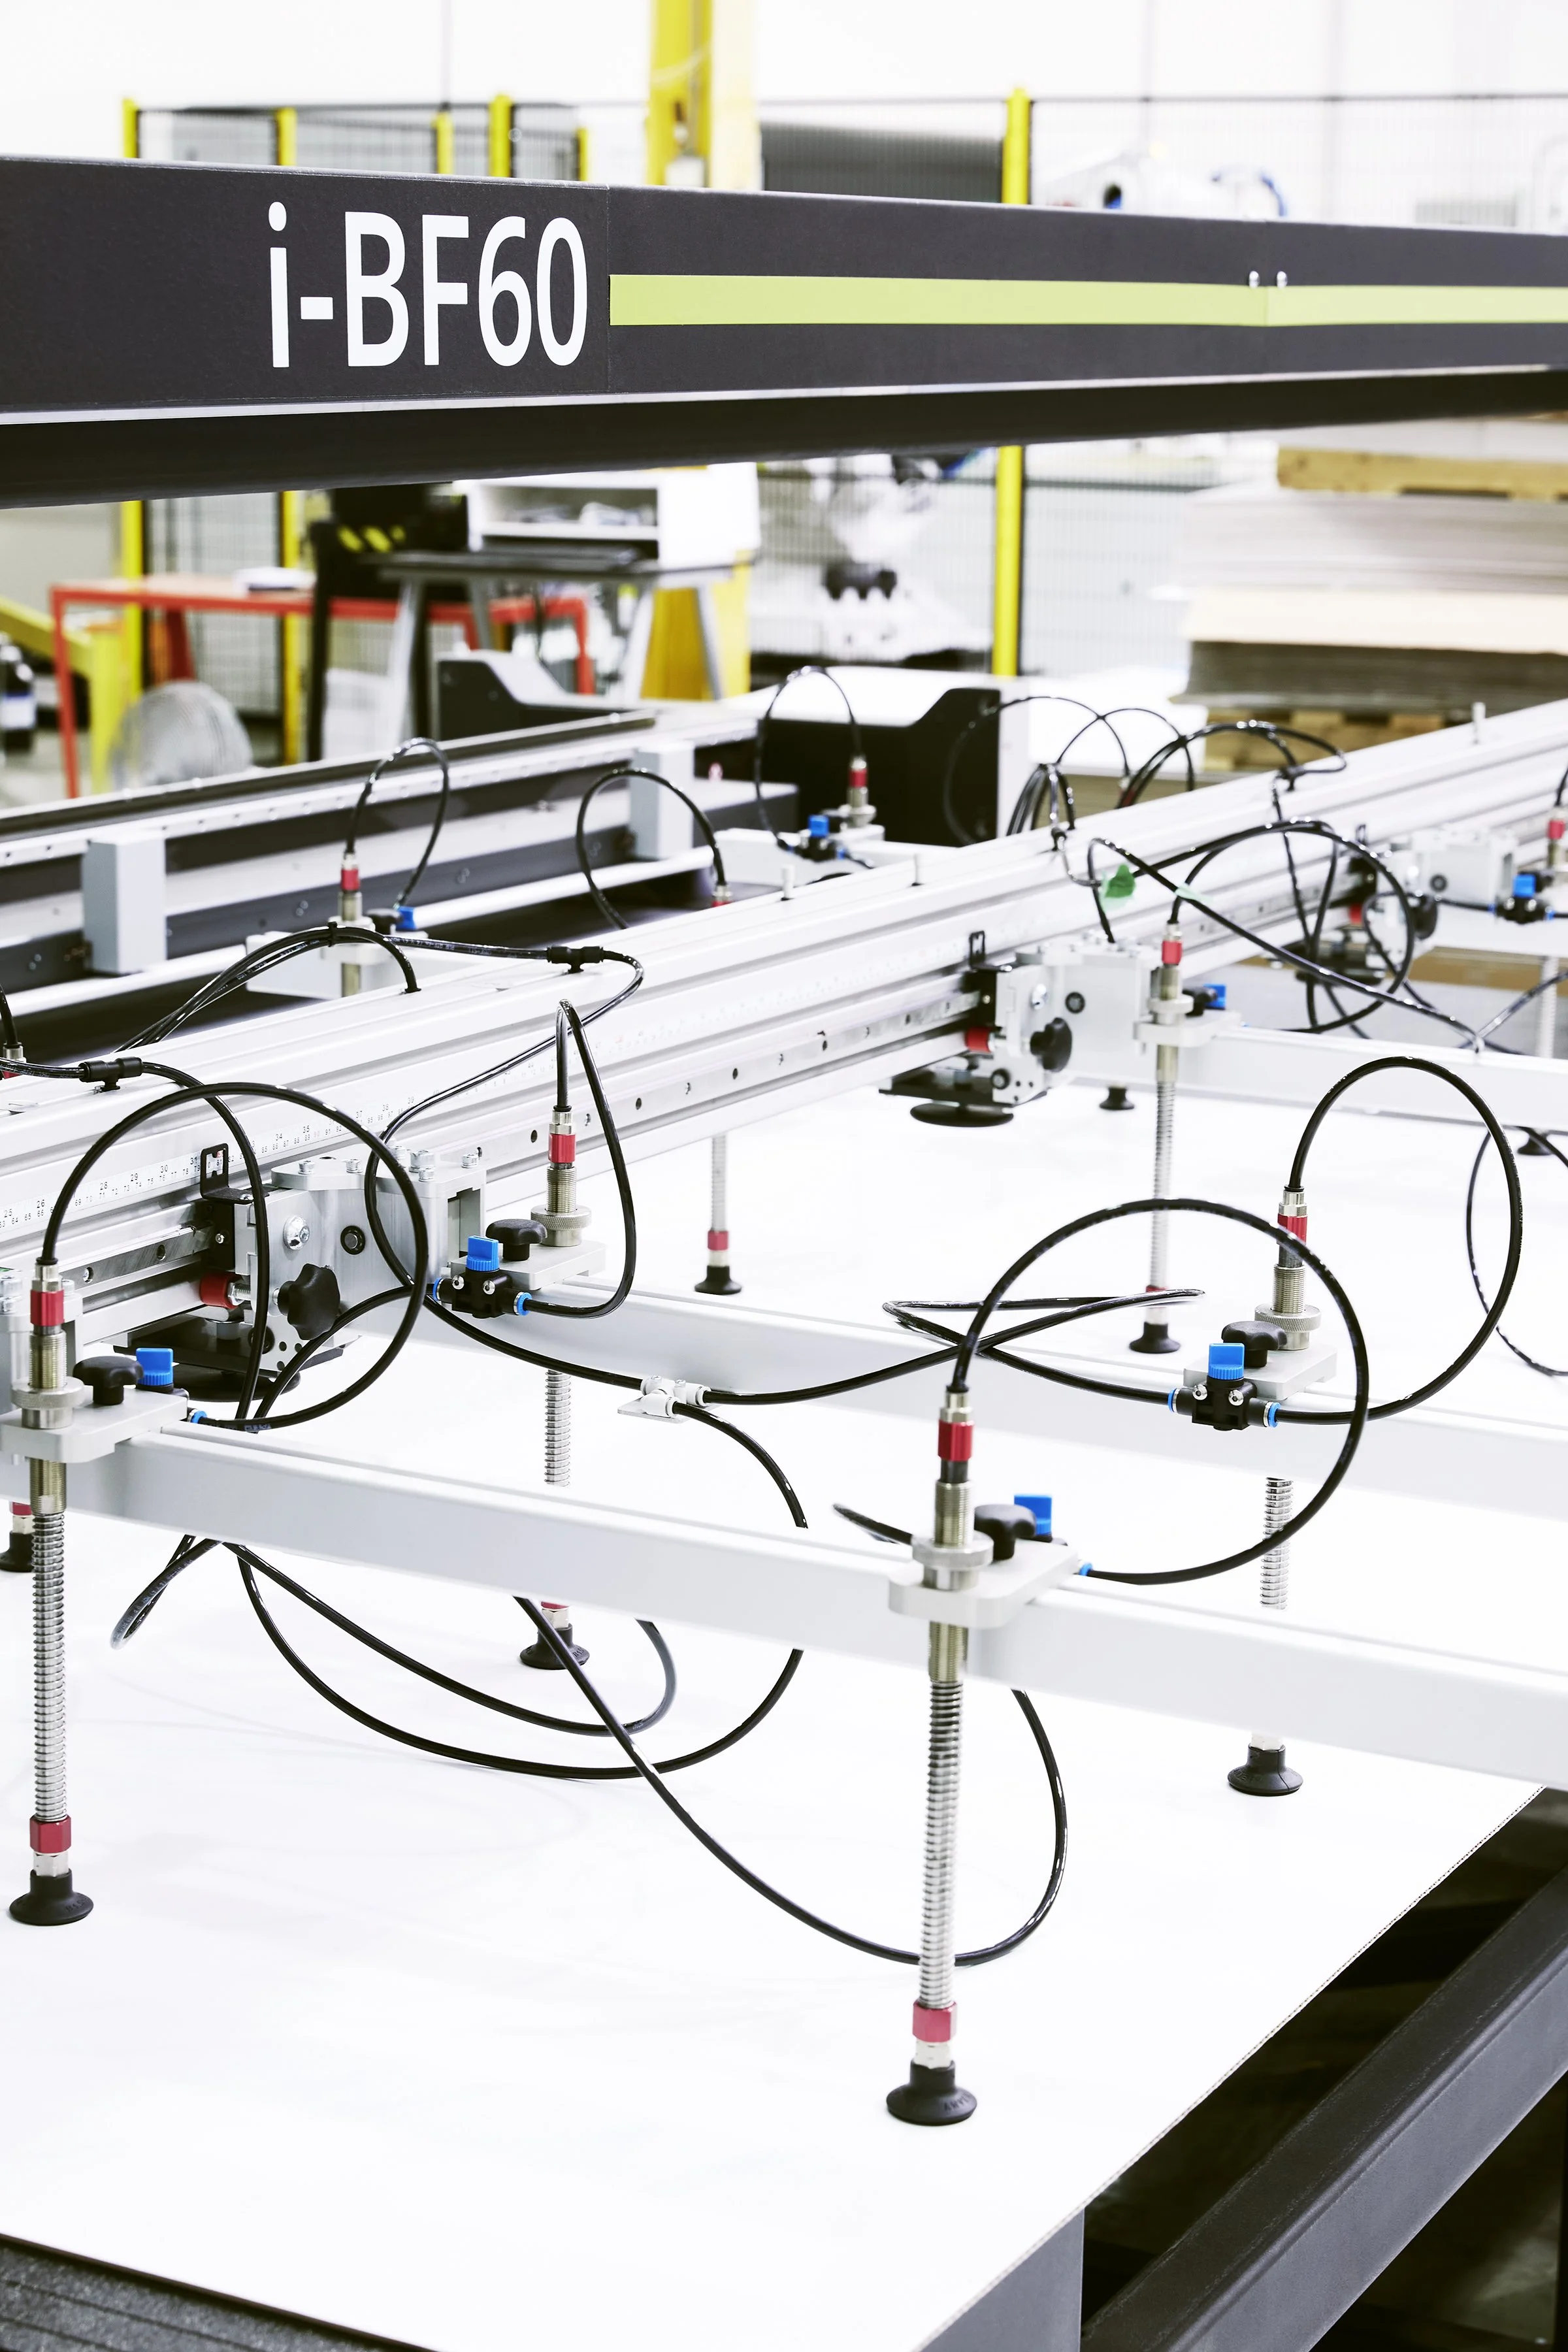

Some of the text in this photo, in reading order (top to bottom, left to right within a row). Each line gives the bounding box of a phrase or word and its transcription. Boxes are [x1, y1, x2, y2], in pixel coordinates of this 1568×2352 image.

[268, 201, 588, 368] i-BF60
[37, 1199, 45, 1209] 26
[99, 1181, 108, 1190] 28
[131, 1173, 139, 1182] 29
[160, 1164, 169, 1173] 30
[190, 1156, 197, 1165] 31
[276, 1133, 283, 1141] 34
[303, 1125, 310, 1134] 35
